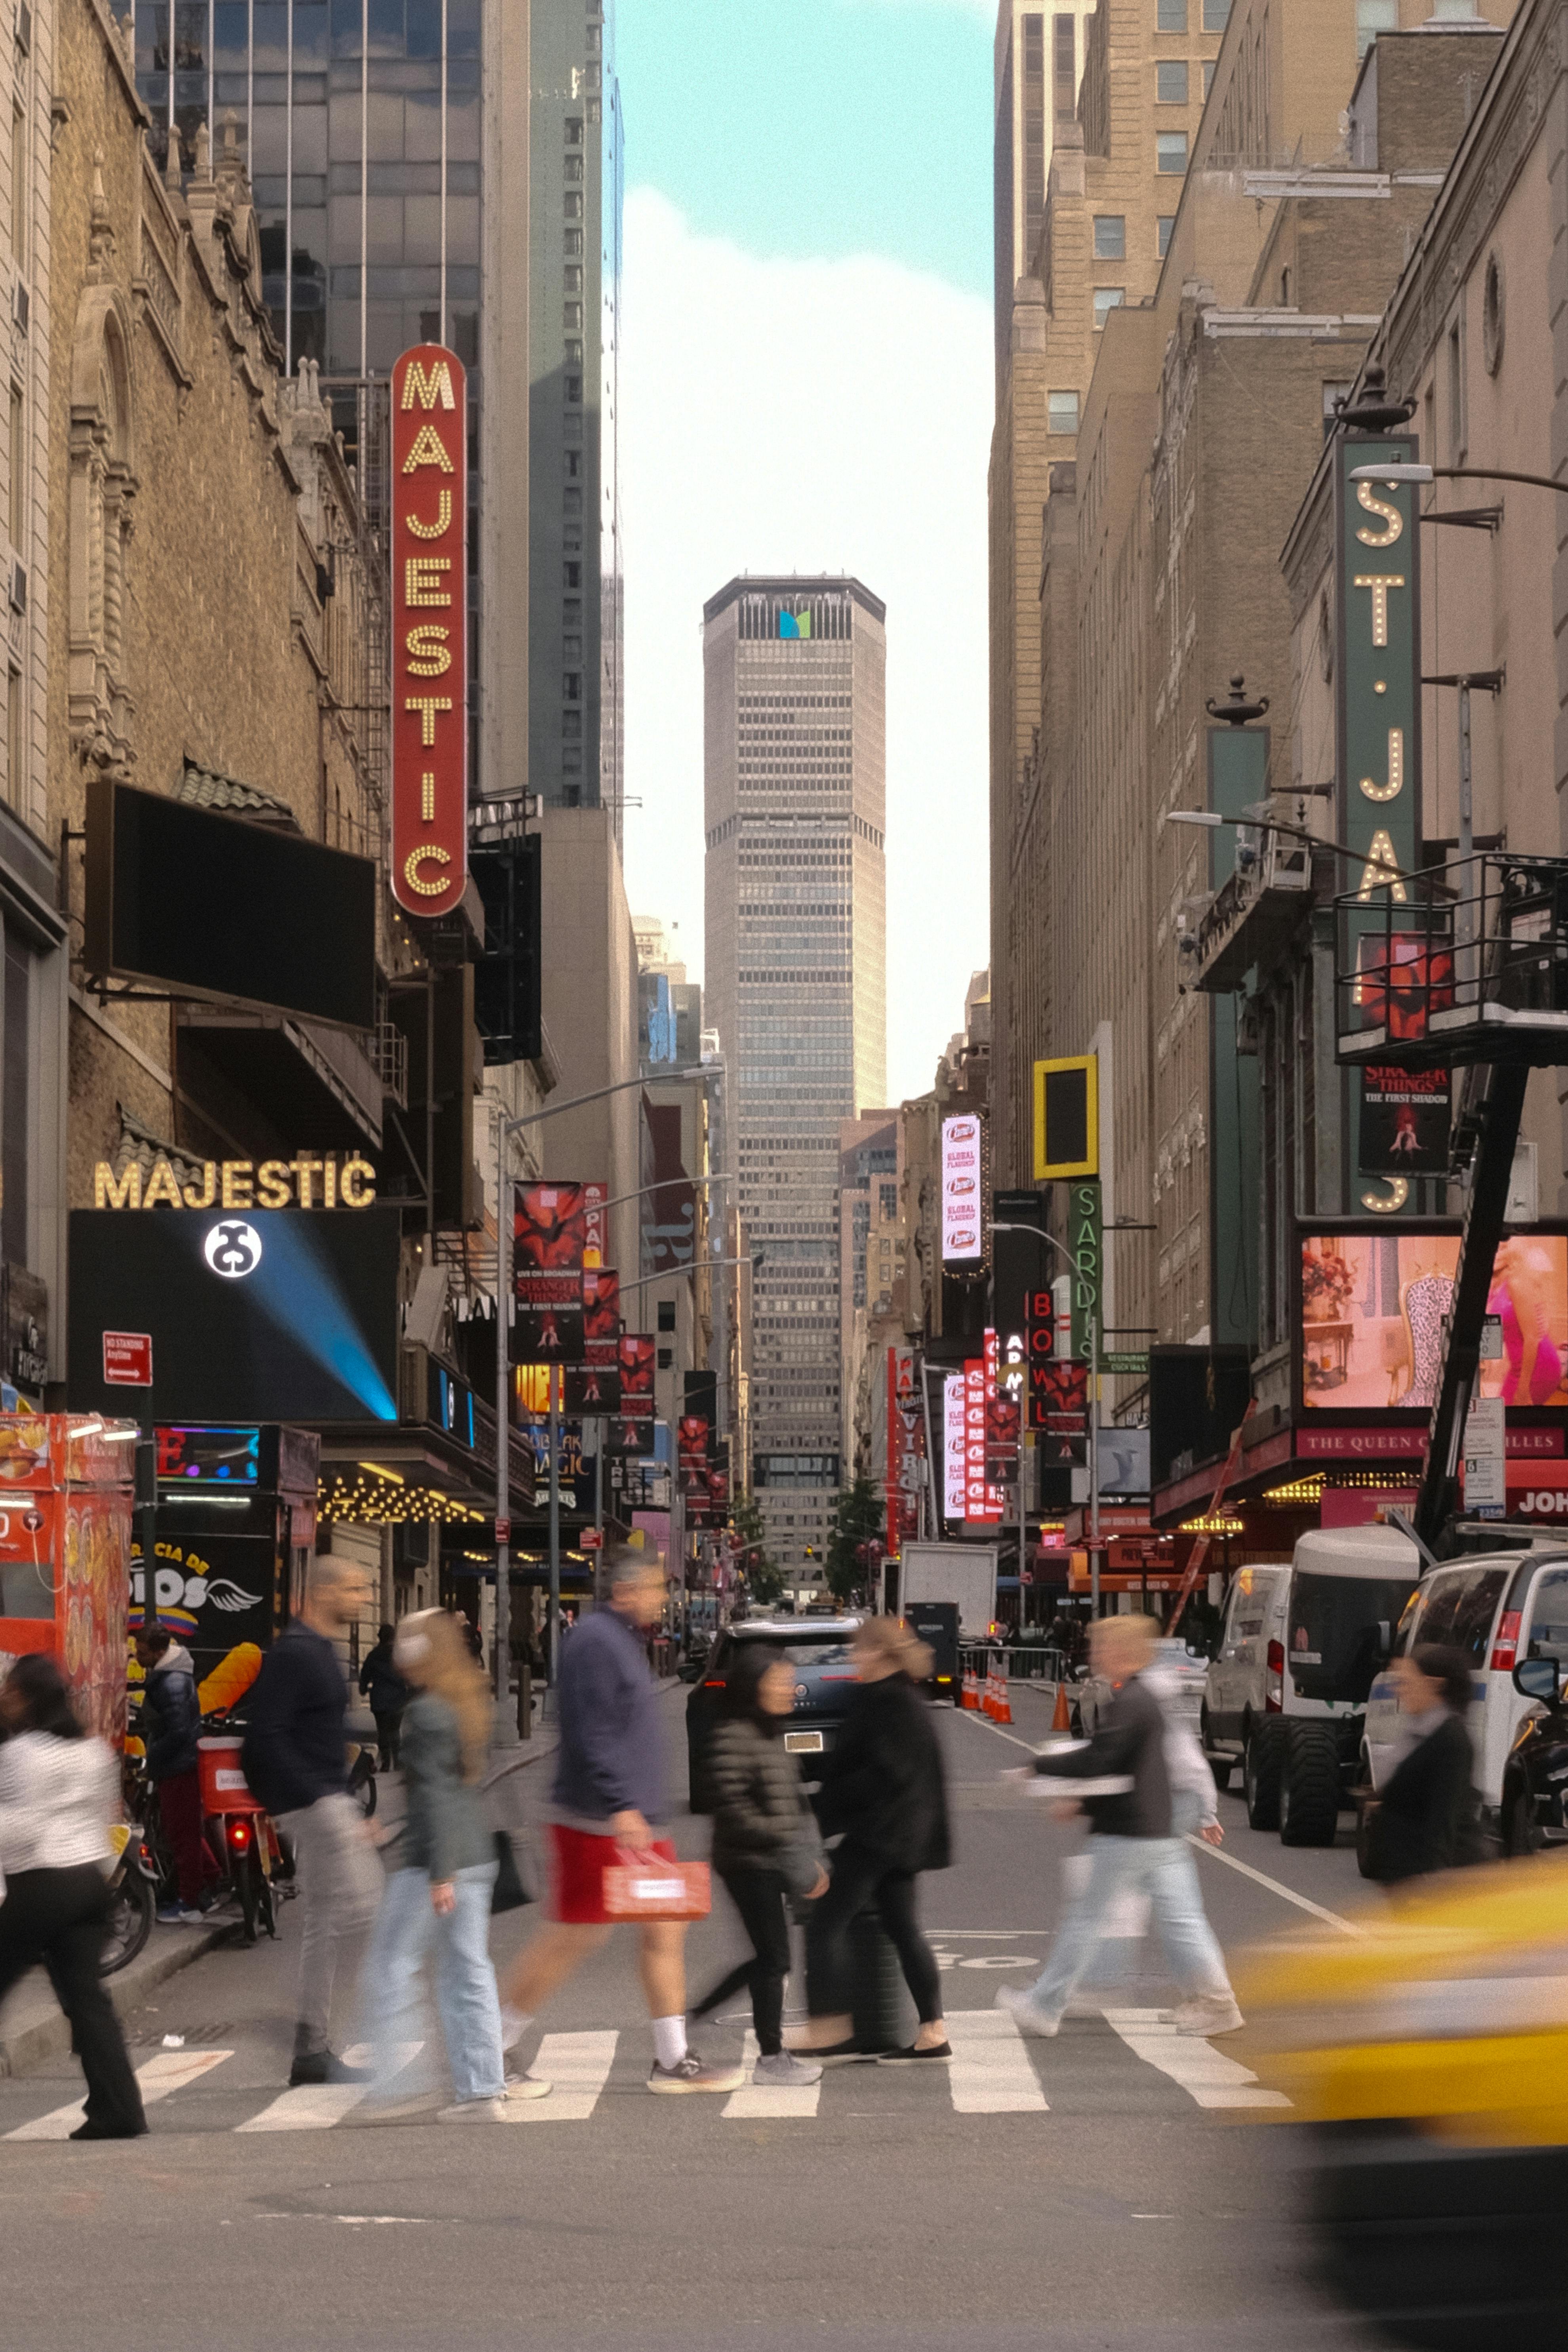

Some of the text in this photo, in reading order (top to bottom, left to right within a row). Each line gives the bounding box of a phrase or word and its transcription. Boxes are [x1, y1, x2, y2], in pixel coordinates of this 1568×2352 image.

[401, 361, 455, 896] MAJESTIC
[1379, 1078, 1435, 1093] THINGS
[1366, 1093, 1448, 1104] THE FIRST SHADOW
[947, 1151, 974, 1161] GLOBAL
[95, 1160, 377, 1209] MAJESTIC
[948, 1205, 975, 1214] GLOBAL
[517, 1278, 581, 1295] STRANGER
[107, 1338, 144, 1350] NO STANDING
[107, 1349, 131, 1360] Anytime
[1308, 1437, 1344, 1449] THE
[1351, 1436, 1411, 1451] QUEEN
[535, 1452, 590, 1476] AGIC
